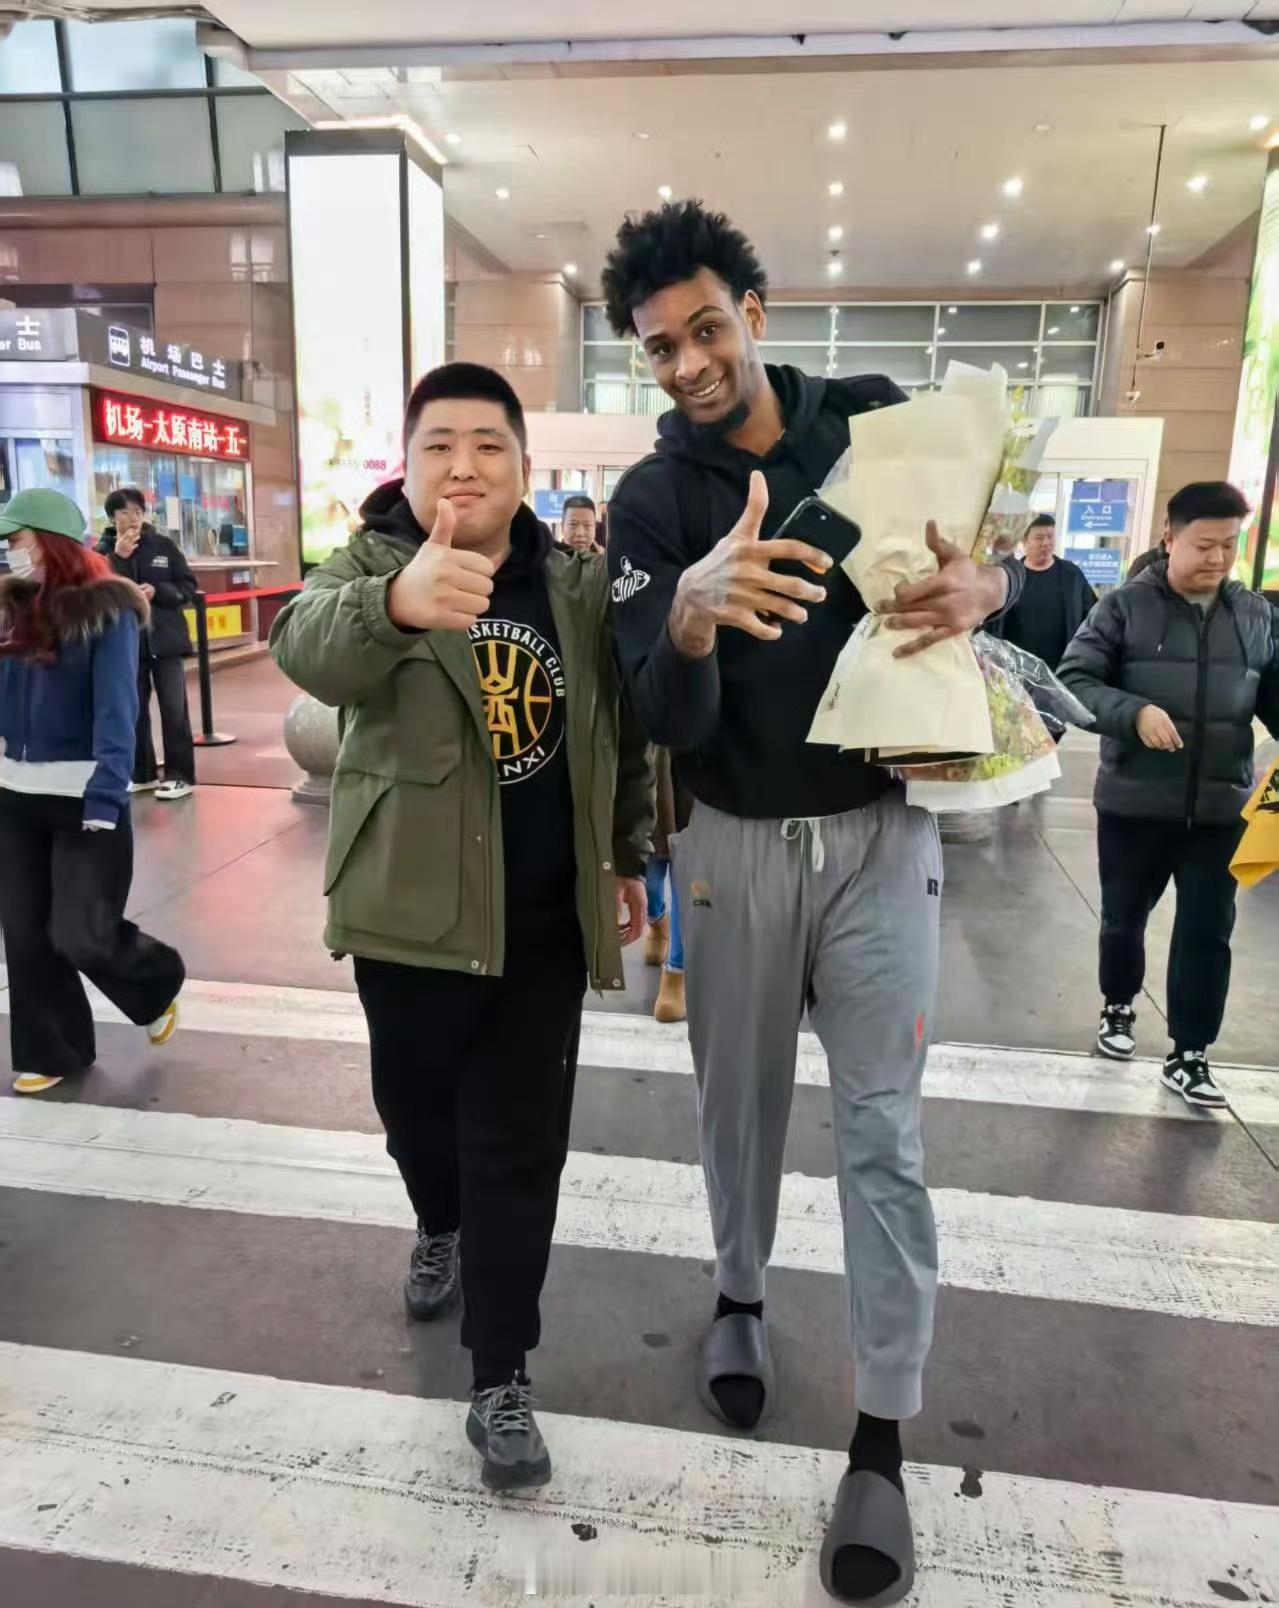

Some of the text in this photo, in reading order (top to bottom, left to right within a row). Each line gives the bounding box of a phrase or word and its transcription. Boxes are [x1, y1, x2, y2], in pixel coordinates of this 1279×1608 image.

[18, 337, 42, 351] Bus
[141, 357, 169, 374] Airport
[545, 656, 566, 698] CLUB
